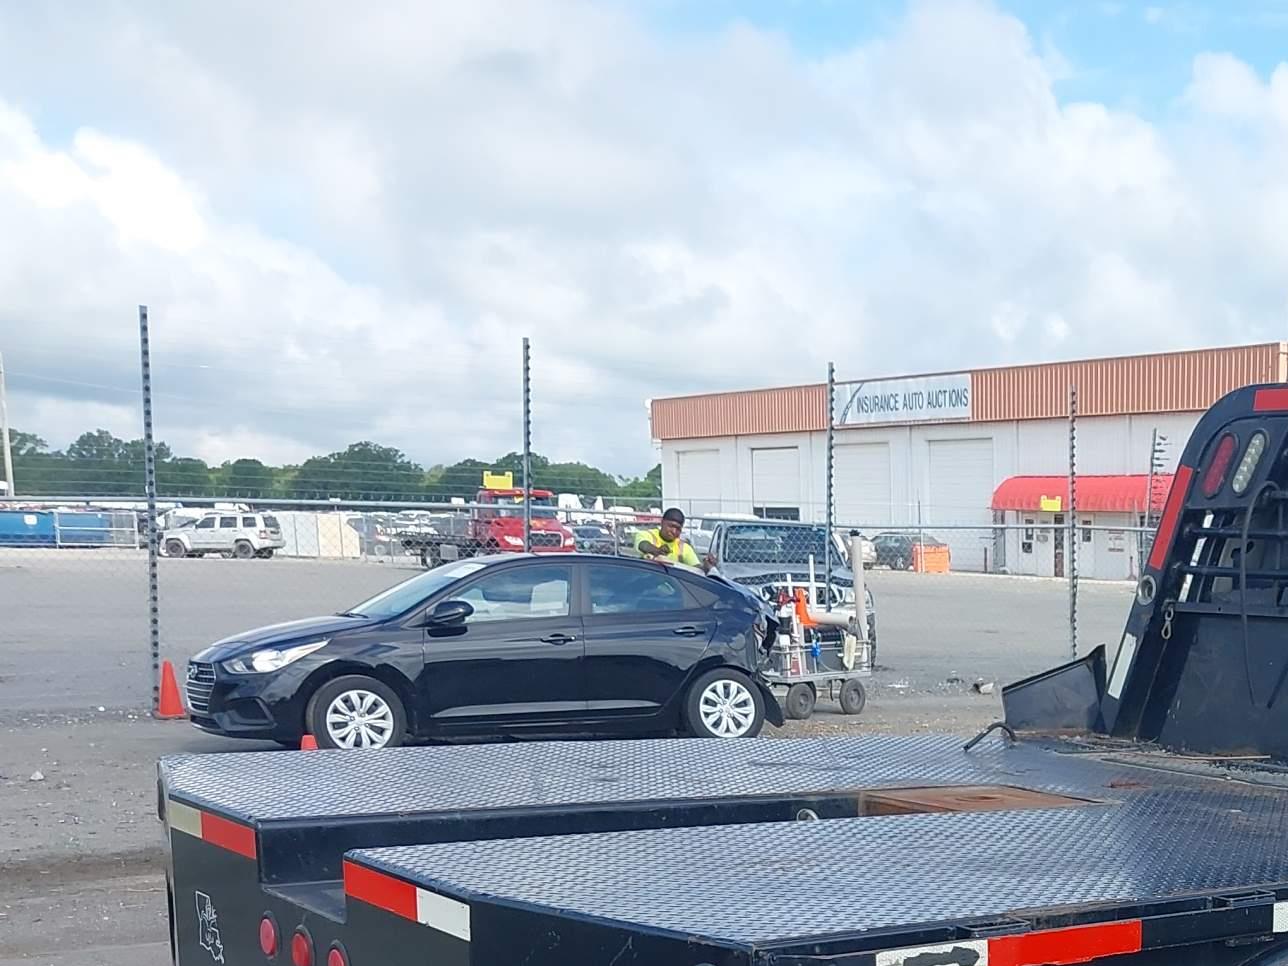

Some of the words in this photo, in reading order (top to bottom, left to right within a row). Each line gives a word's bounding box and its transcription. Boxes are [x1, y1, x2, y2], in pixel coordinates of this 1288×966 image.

[856, 394, 899, 414] INSURANCE
[902, 392, 924, 410] AUTO
[927, 388, 969, 409] AUCTIONS
